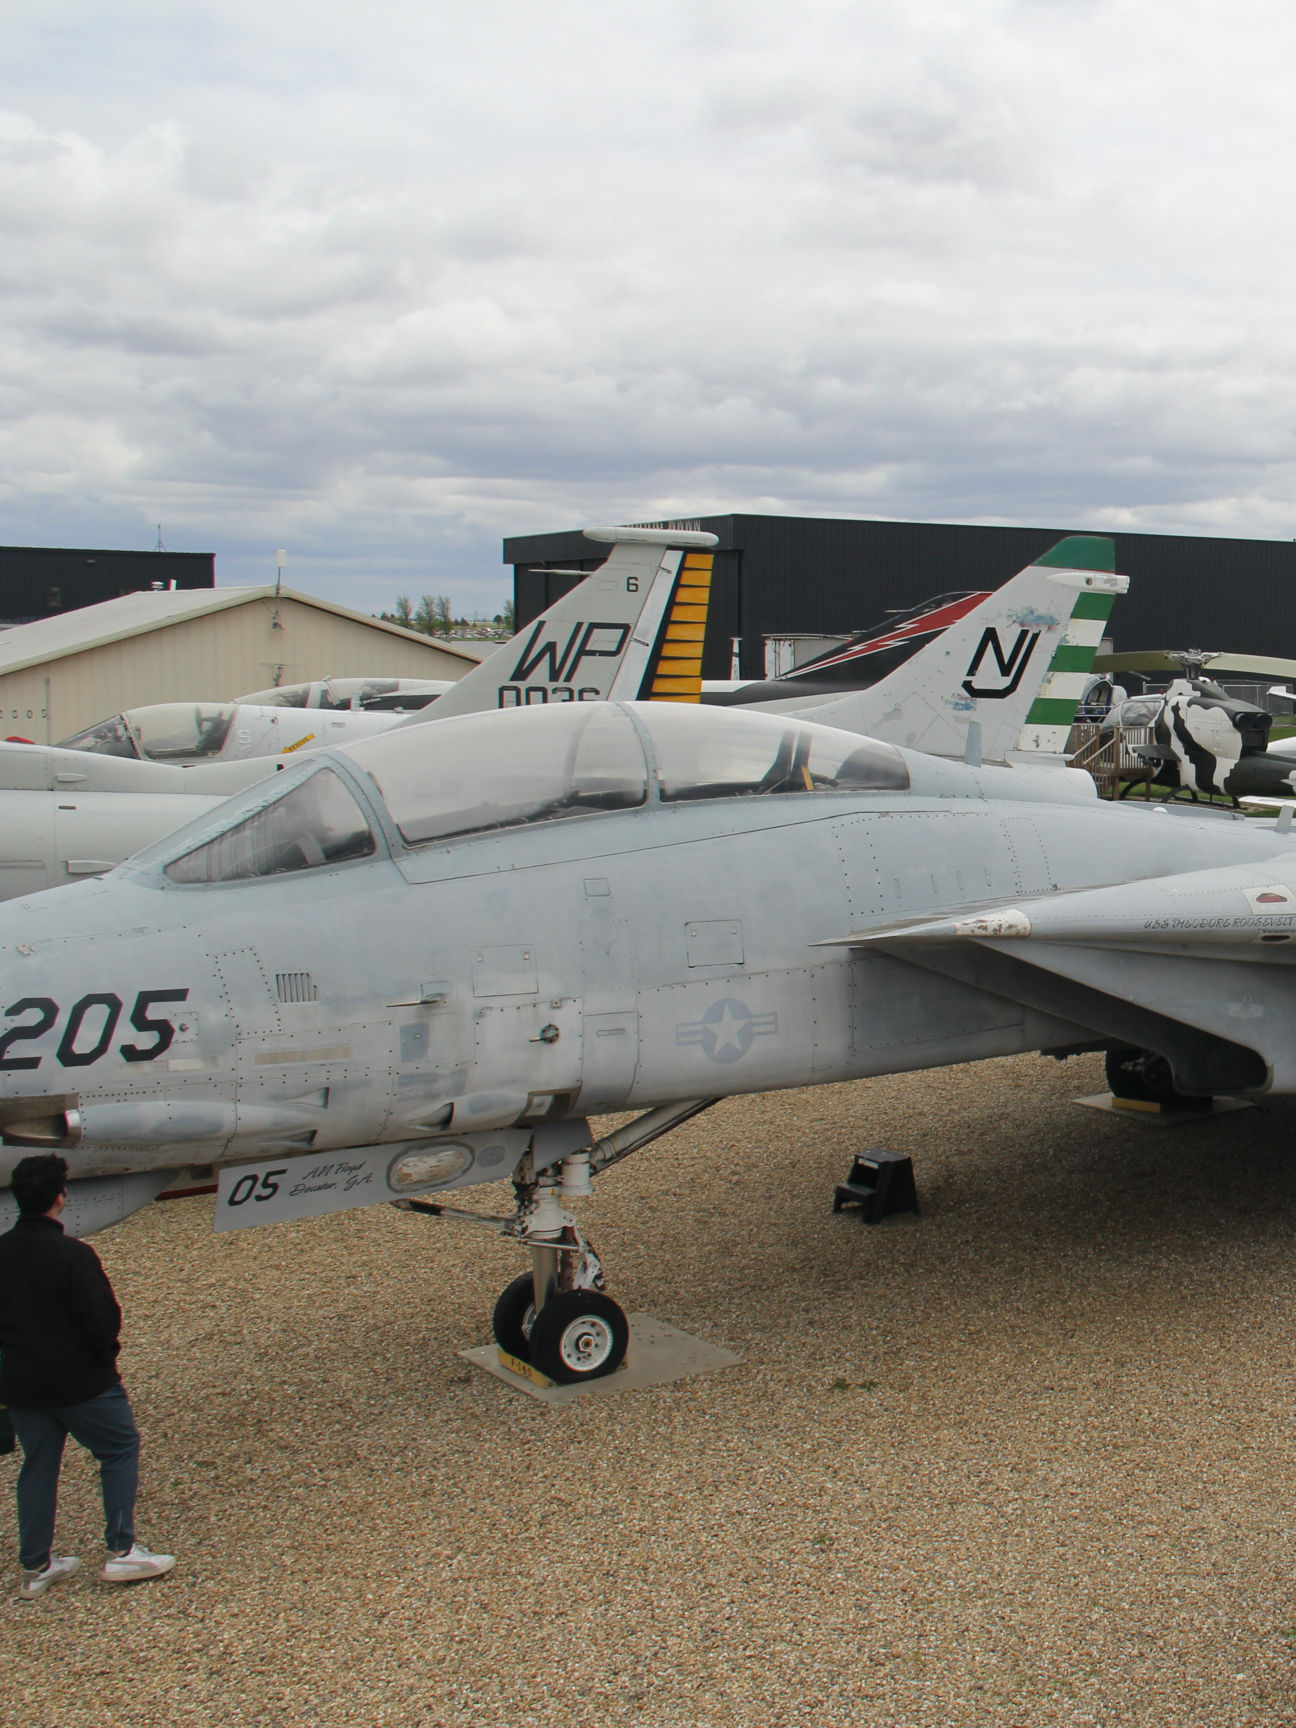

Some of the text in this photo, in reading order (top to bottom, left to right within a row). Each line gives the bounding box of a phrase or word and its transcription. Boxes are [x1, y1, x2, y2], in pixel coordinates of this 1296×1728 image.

[626, 577, 639, 592] 6
[509, 620, 632, 682] WP
[961, 626, 1041, 699] NJ
[1144, 916, 1295, 929] USS THEODORE ROOSEVELT
[0, 988, 190, 1071] 205
[228, 1168, 288, 1207] 05
